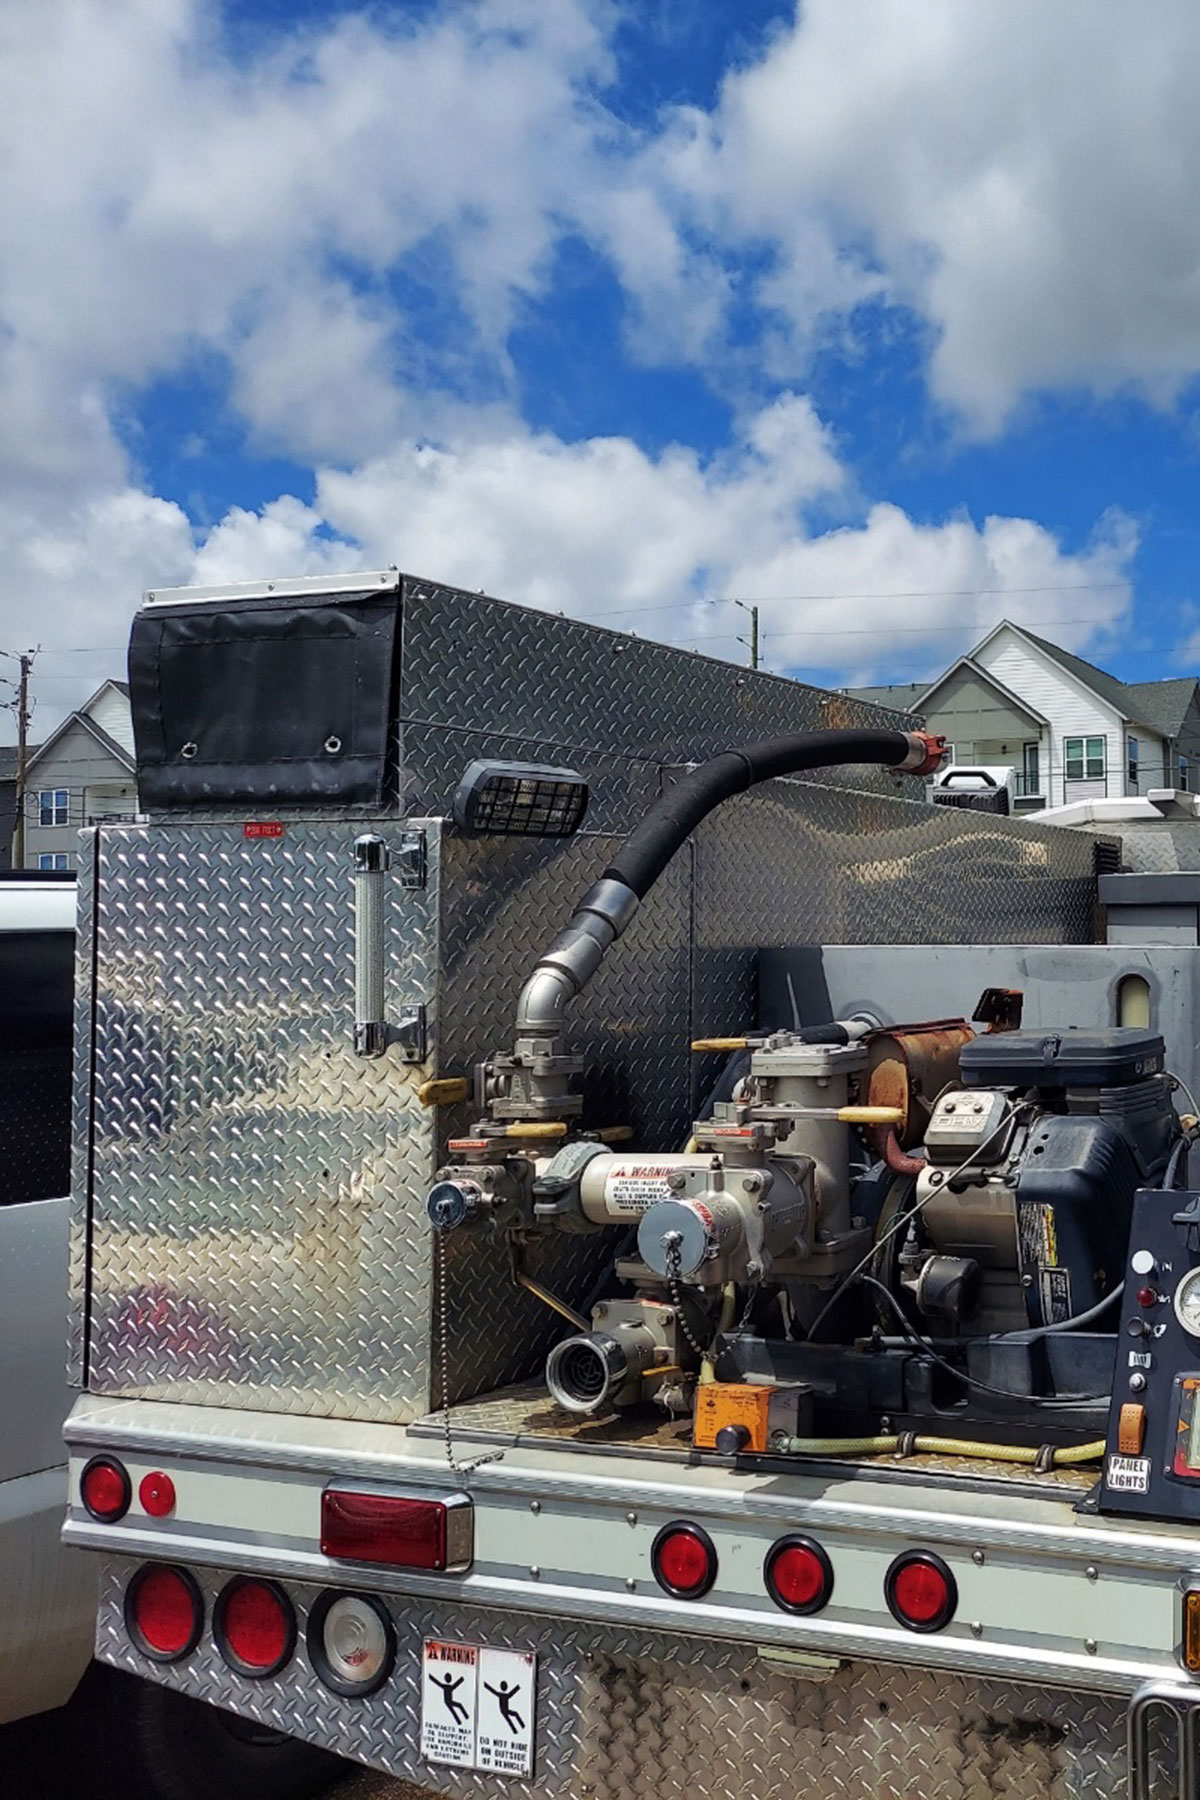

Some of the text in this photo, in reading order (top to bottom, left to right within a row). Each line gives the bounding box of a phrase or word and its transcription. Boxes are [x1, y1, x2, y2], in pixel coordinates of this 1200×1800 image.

[632, 1167, 673, 1176] WARNIN
[1113, 1458, 1144, 1472] PANEL
[1110, 1475, 1145, 1488] LIGHTS
[440, 1645, 475, 1665] WARNING
[480, 1736, 528, 1752] DO NOT RIDE
[481, 1747, 527, 1762] ON OUTSIDE
[482, 1757, 525, 1771] OF VEHICLE
